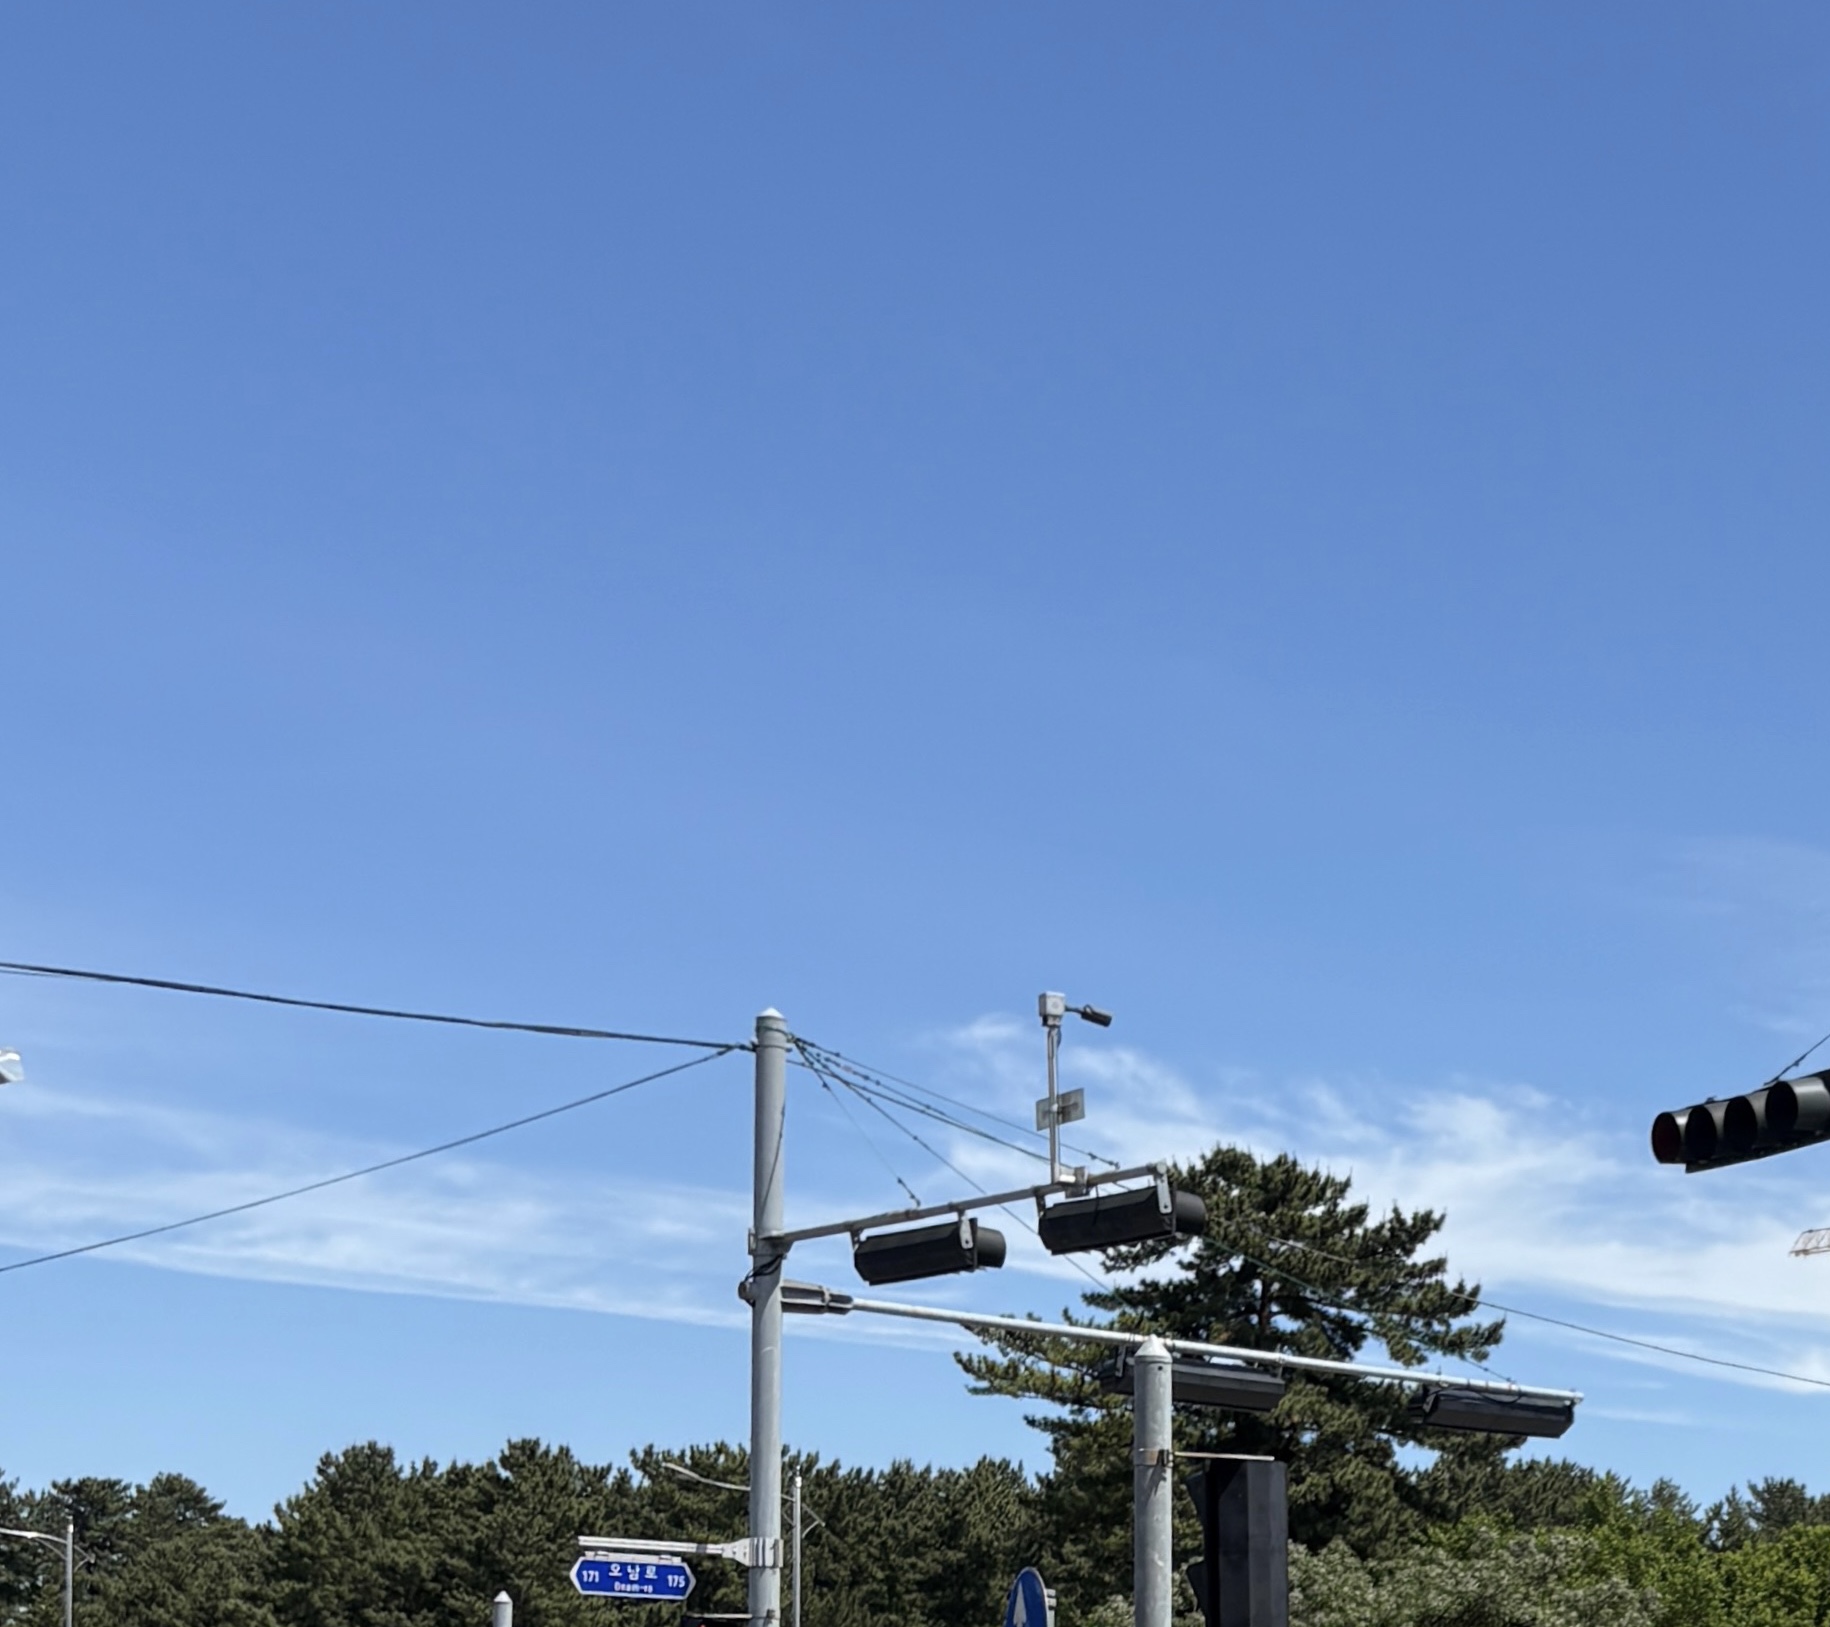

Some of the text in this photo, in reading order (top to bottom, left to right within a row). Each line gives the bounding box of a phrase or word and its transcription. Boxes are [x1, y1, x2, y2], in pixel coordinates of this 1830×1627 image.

[582, 1563, 686, 1588] 171 오남로 175
